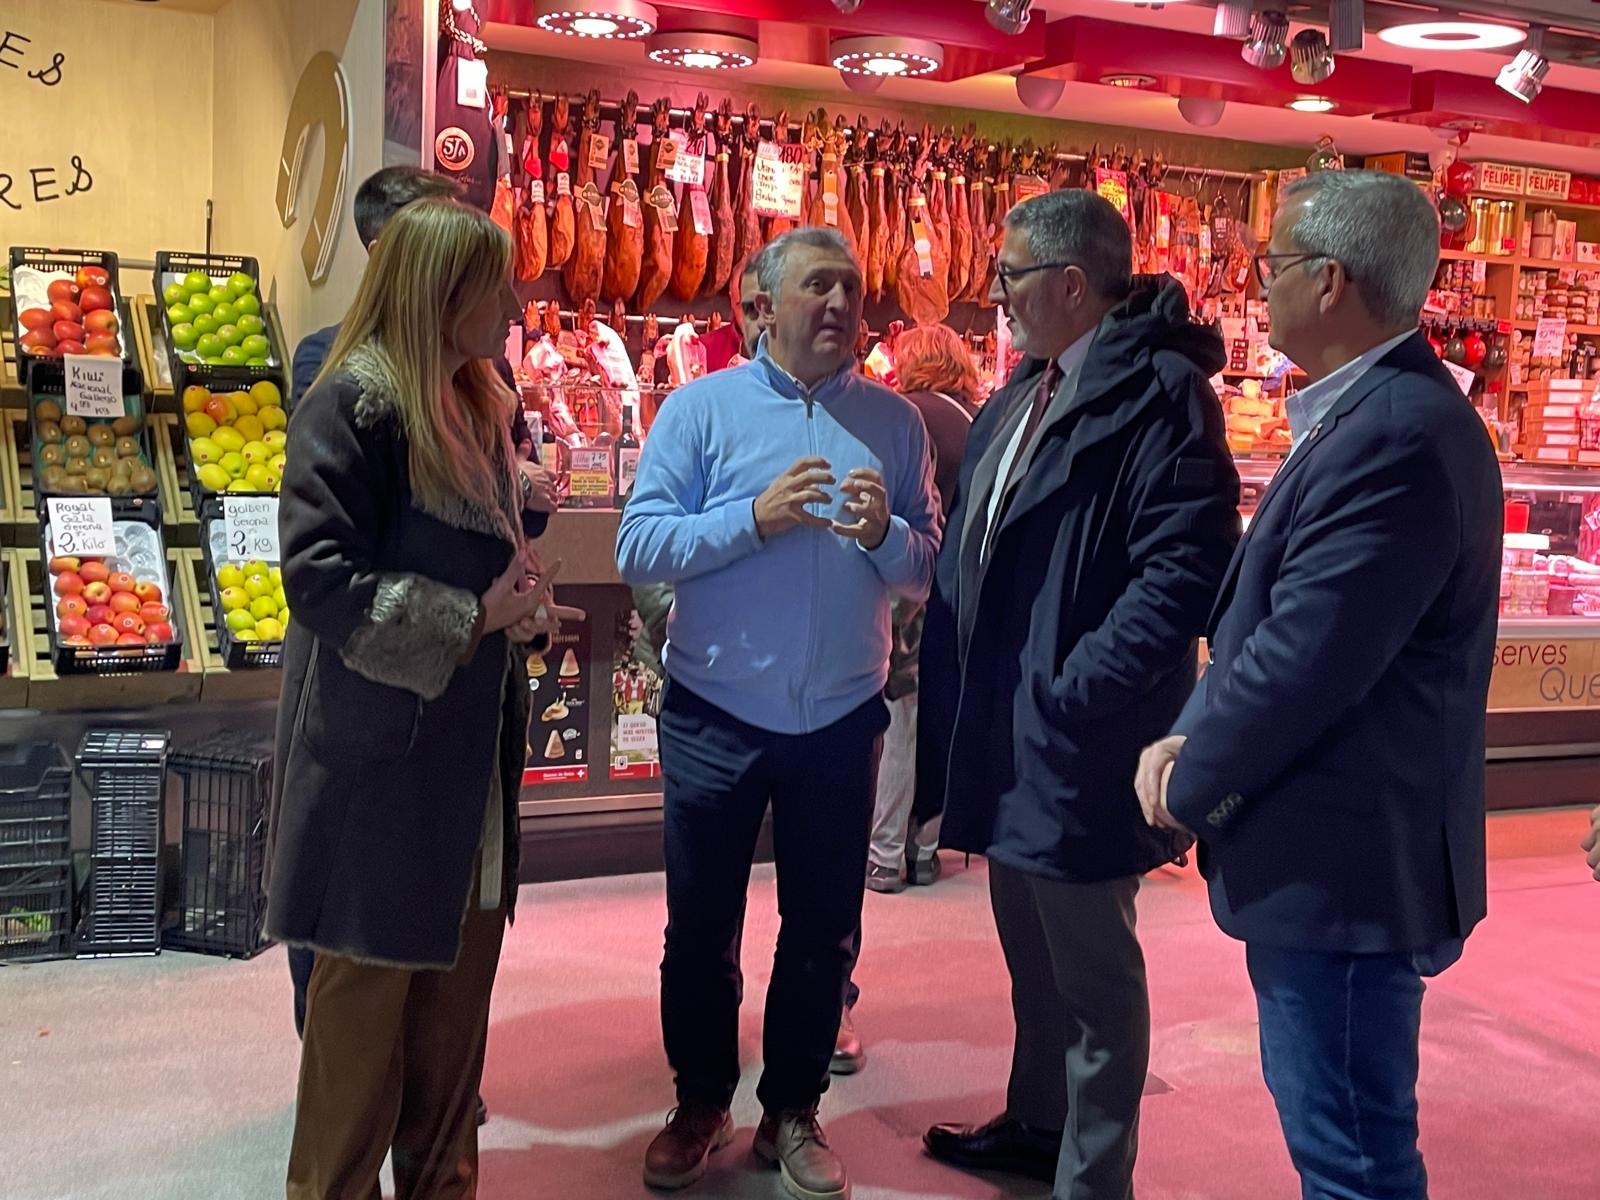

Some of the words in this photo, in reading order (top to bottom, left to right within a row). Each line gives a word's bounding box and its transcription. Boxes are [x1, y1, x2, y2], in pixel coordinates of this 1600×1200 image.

[1484, 169, 1515, 186] FELIPE
[1529, 175, 1560, 192] FELIPE
[56, 502, 95, 515] Royal
[61, 513, 95, 523] Gala
